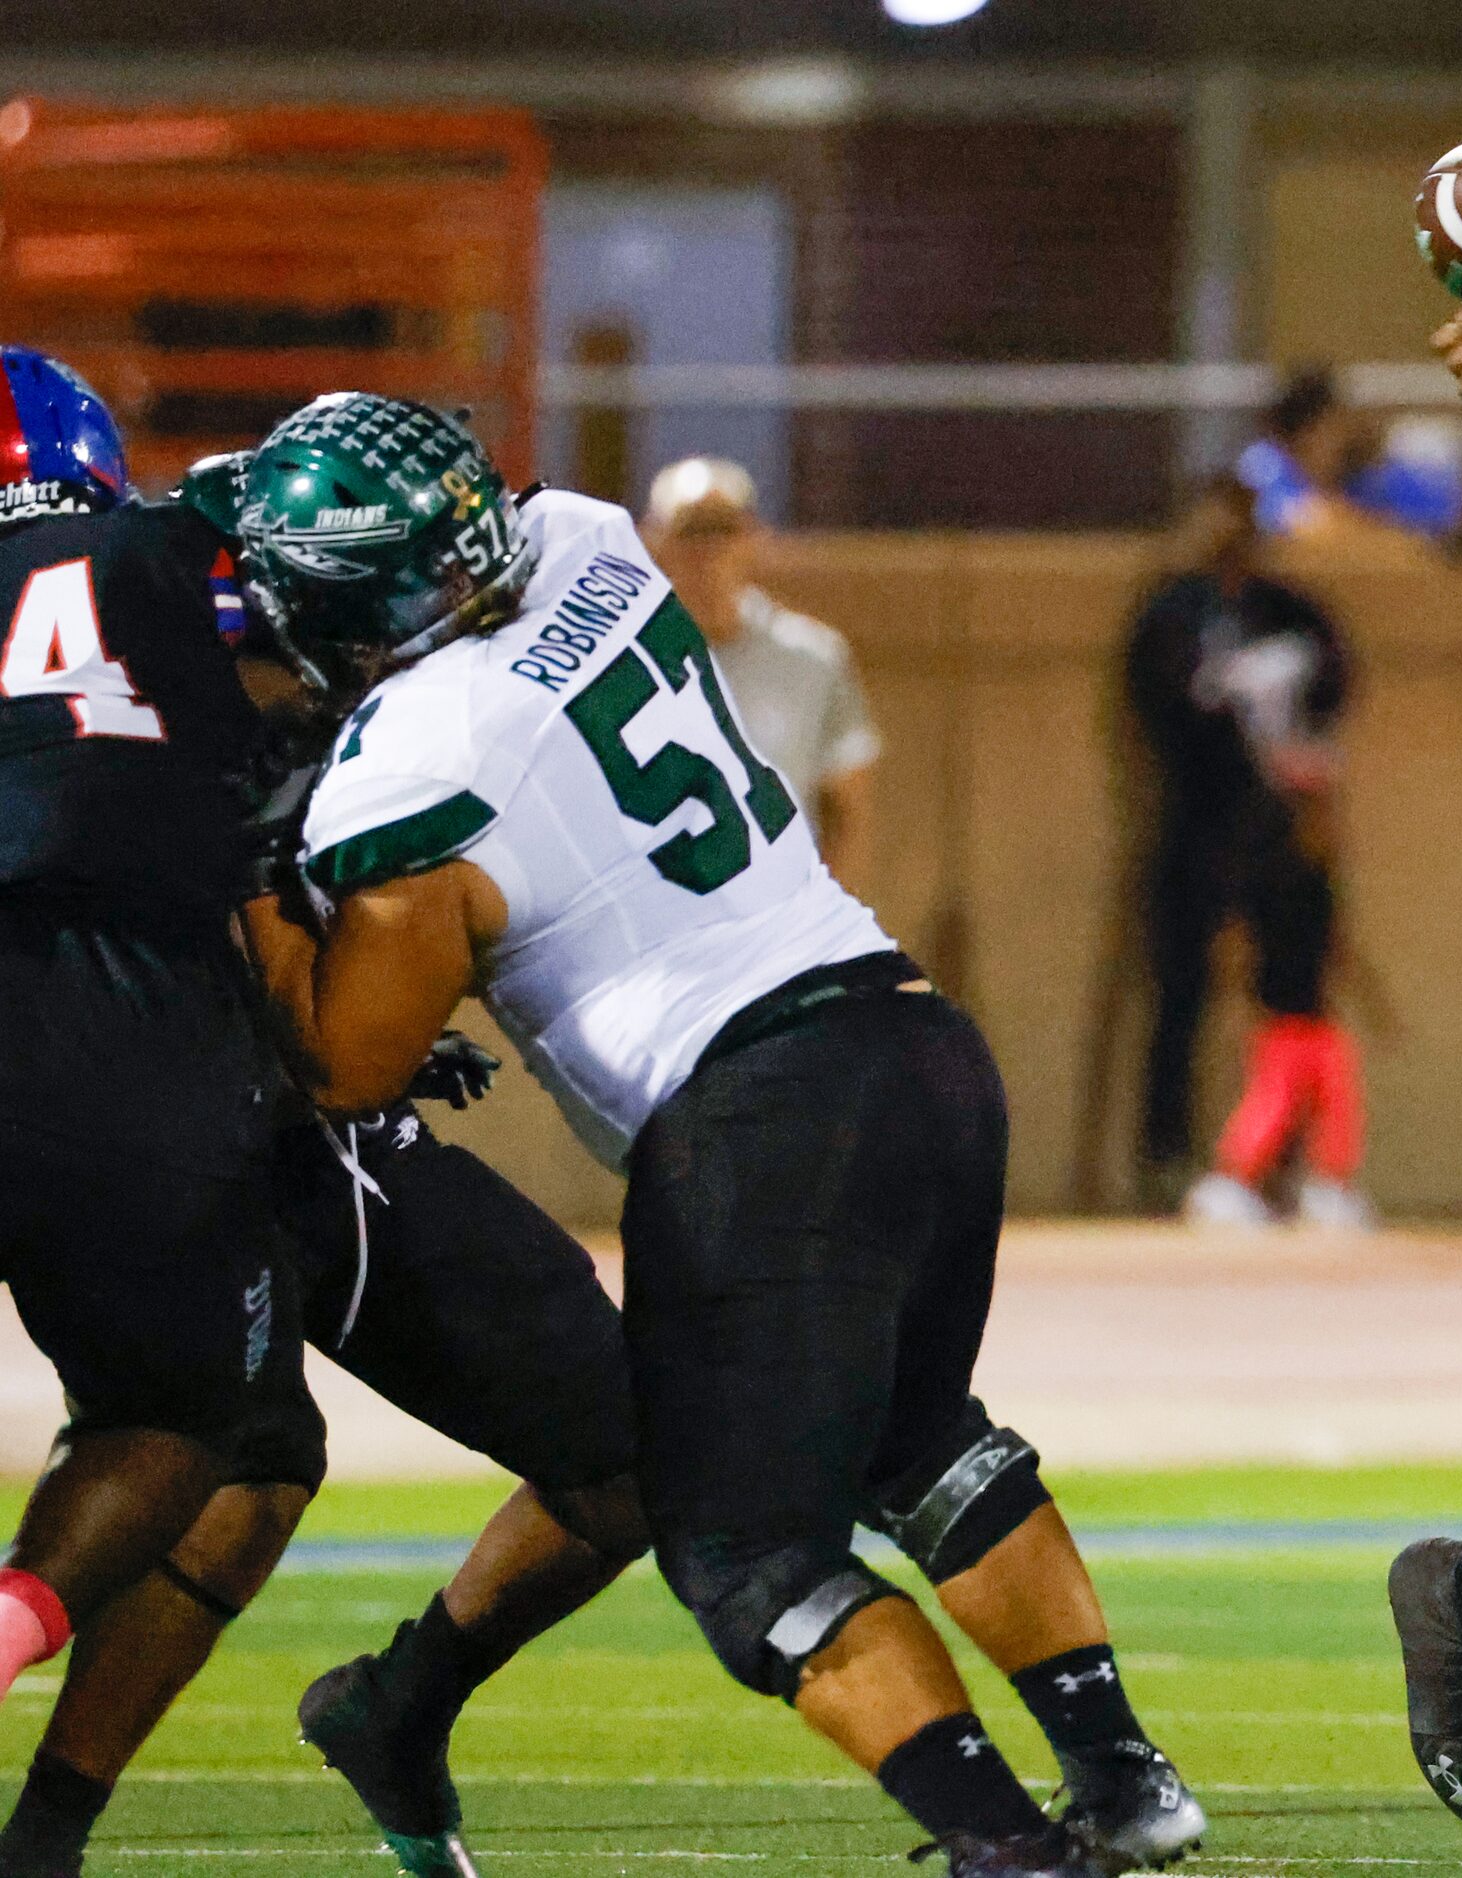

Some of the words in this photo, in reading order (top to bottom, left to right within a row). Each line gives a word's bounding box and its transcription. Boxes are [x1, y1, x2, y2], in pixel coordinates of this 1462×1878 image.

[315, 503, 389, 529] INDIANS
[455, 507, 504, 576] 57
[0, 555, 168, 743] 4
[508, 551, 652, 693] ROBINSON
[562, 589, 798, 896] 57
